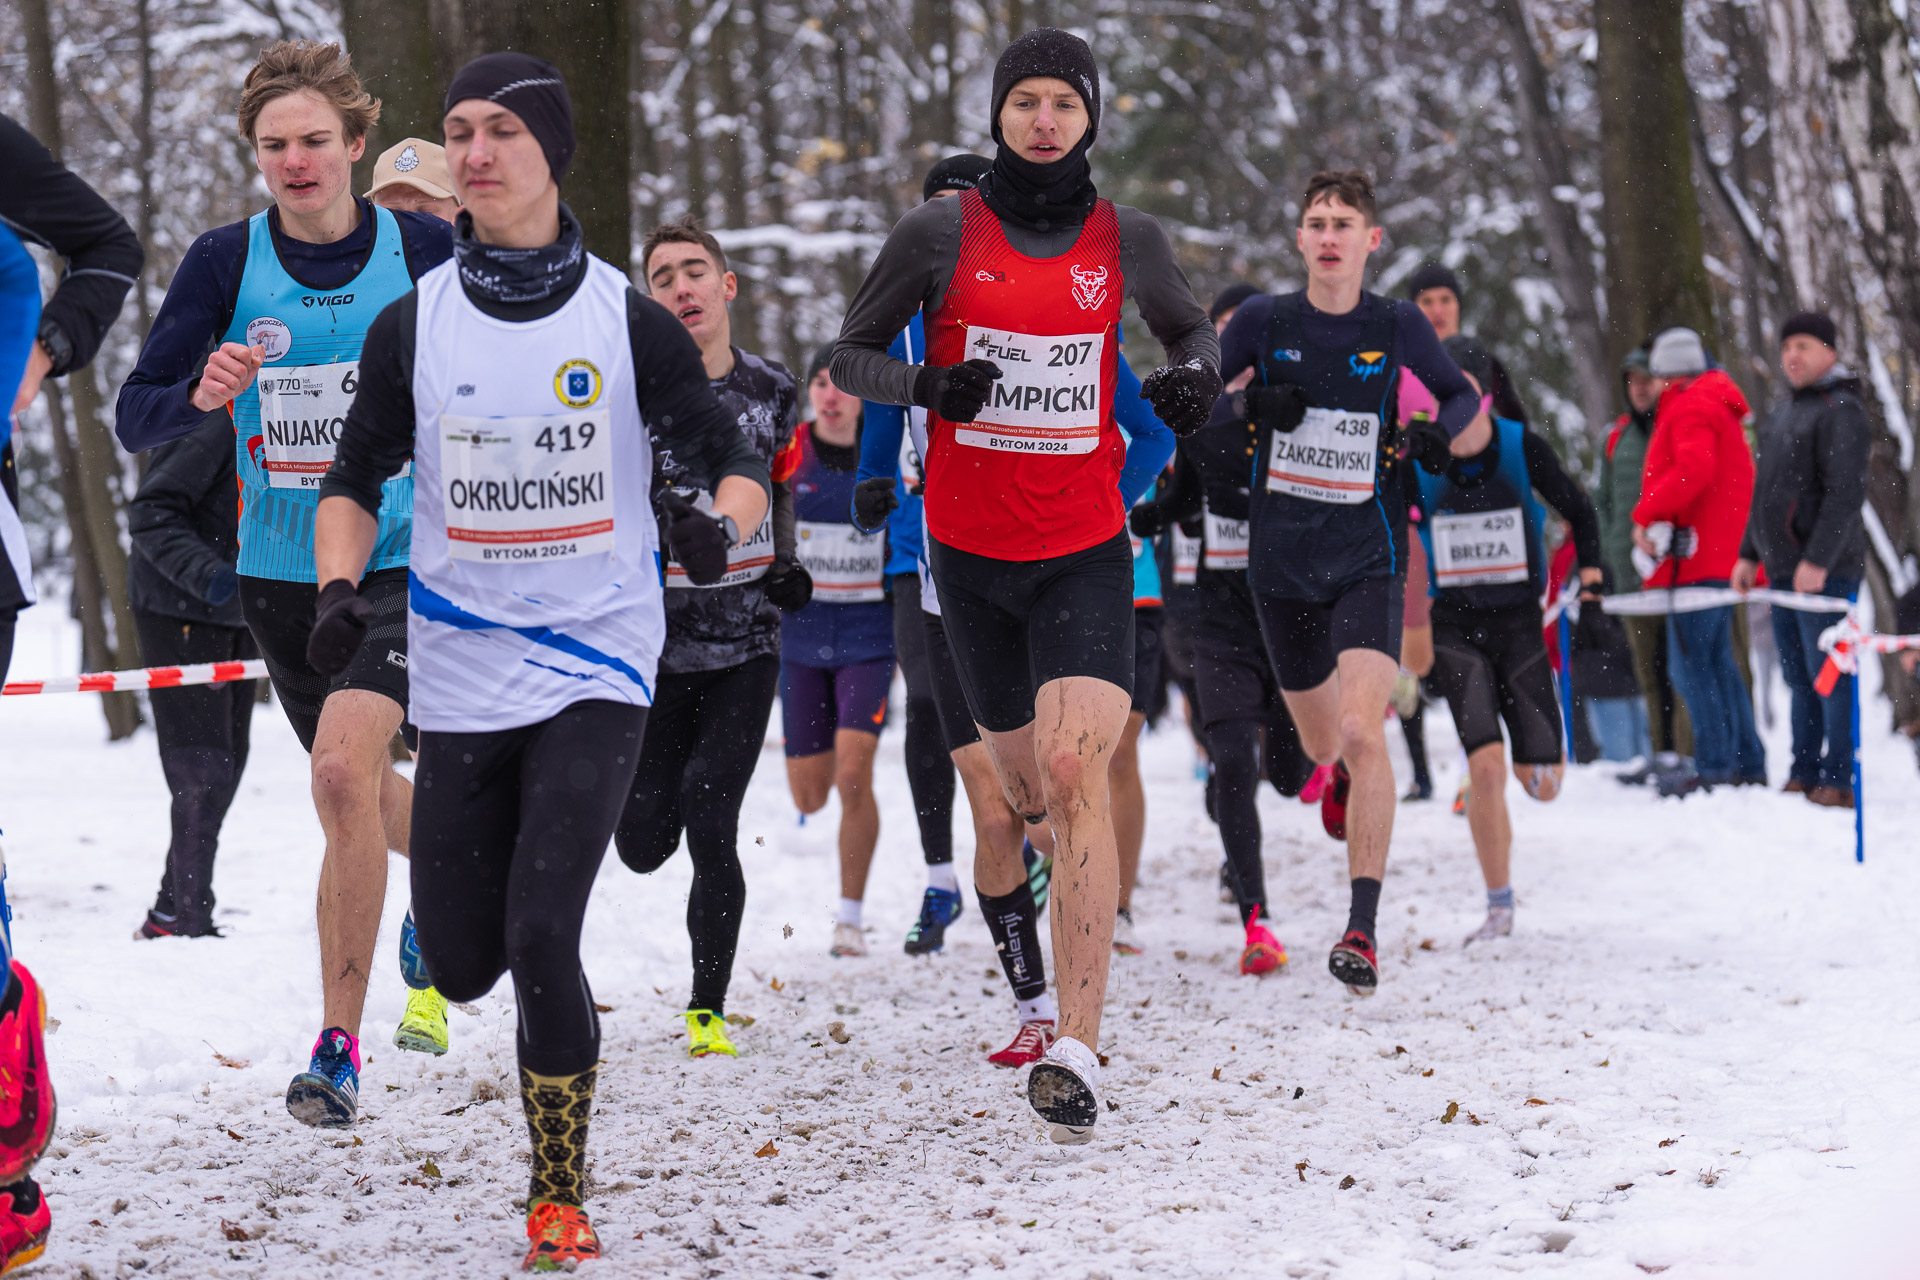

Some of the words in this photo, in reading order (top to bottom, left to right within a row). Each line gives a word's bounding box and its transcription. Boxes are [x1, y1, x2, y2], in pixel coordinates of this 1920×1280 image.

[1048, 342, 1093, 367] 207
[277, 378, 301, 391] 770
[985, 383, 1096, 413] MPICKI
[267, 416, 345, 447] NIJAKO
[534, 421, 596, 453] 419
[971, 422, 984, 430] PZLA
[985, 425, 1018, 434] Mistrzostwa
[1335, 418, 1370, 437] 438
[989, 437, 1036, 451] BYTOM
[1037, 441, 1069, 452] 2024
[1276, 440, 1371, 472] ZAKRZEWSKI
[450, 470, 604, 512] OKRUCIŃSKI
[1483, 513, 1516, 531] 420
[483, 548, 537, 560] BYTOM
[541, 543, 577, 557] 2024
[1450, 541, 1511, 561] BREZA
[731, 571, 752, 581] 2024
